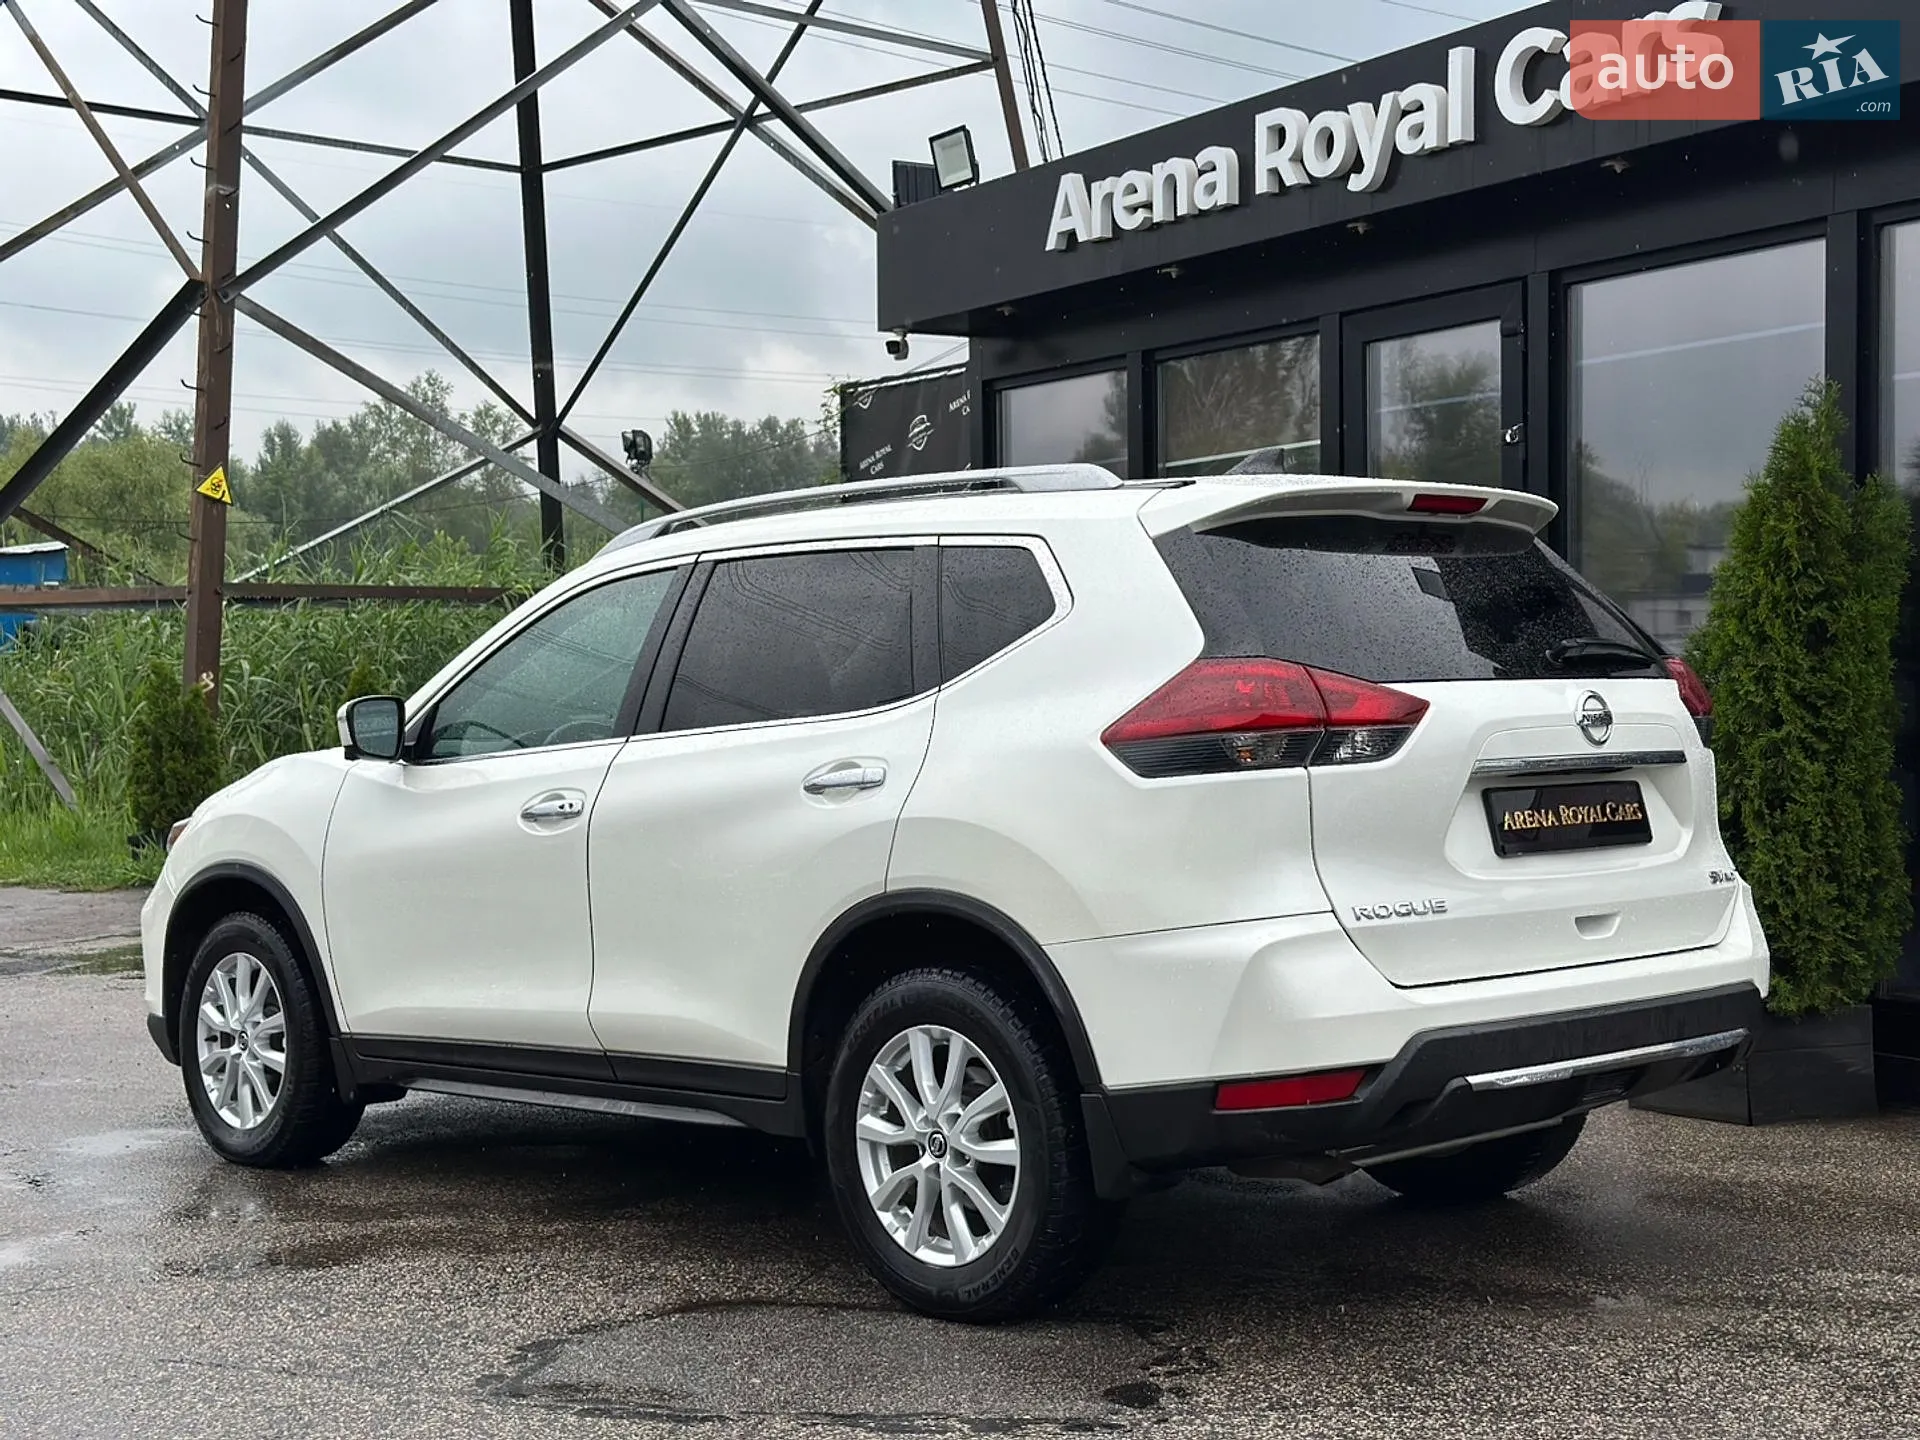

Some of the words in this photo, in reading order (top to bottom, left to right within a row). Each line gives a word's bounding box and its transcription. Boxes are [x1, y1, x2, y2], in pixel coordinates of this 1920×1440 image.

[1044, 145, 1239, 252] Arena
[1254, 46, 1476, 195] Royal
[1495, 1, 1725, 127] Cars
[1503, 808, 1559, 831] ARENA
[1558, 804, 1607, 825] ROYAL
[1606, 801, 1643, 821] CARS
[1351, 898, 1448, 922] ROGUE
